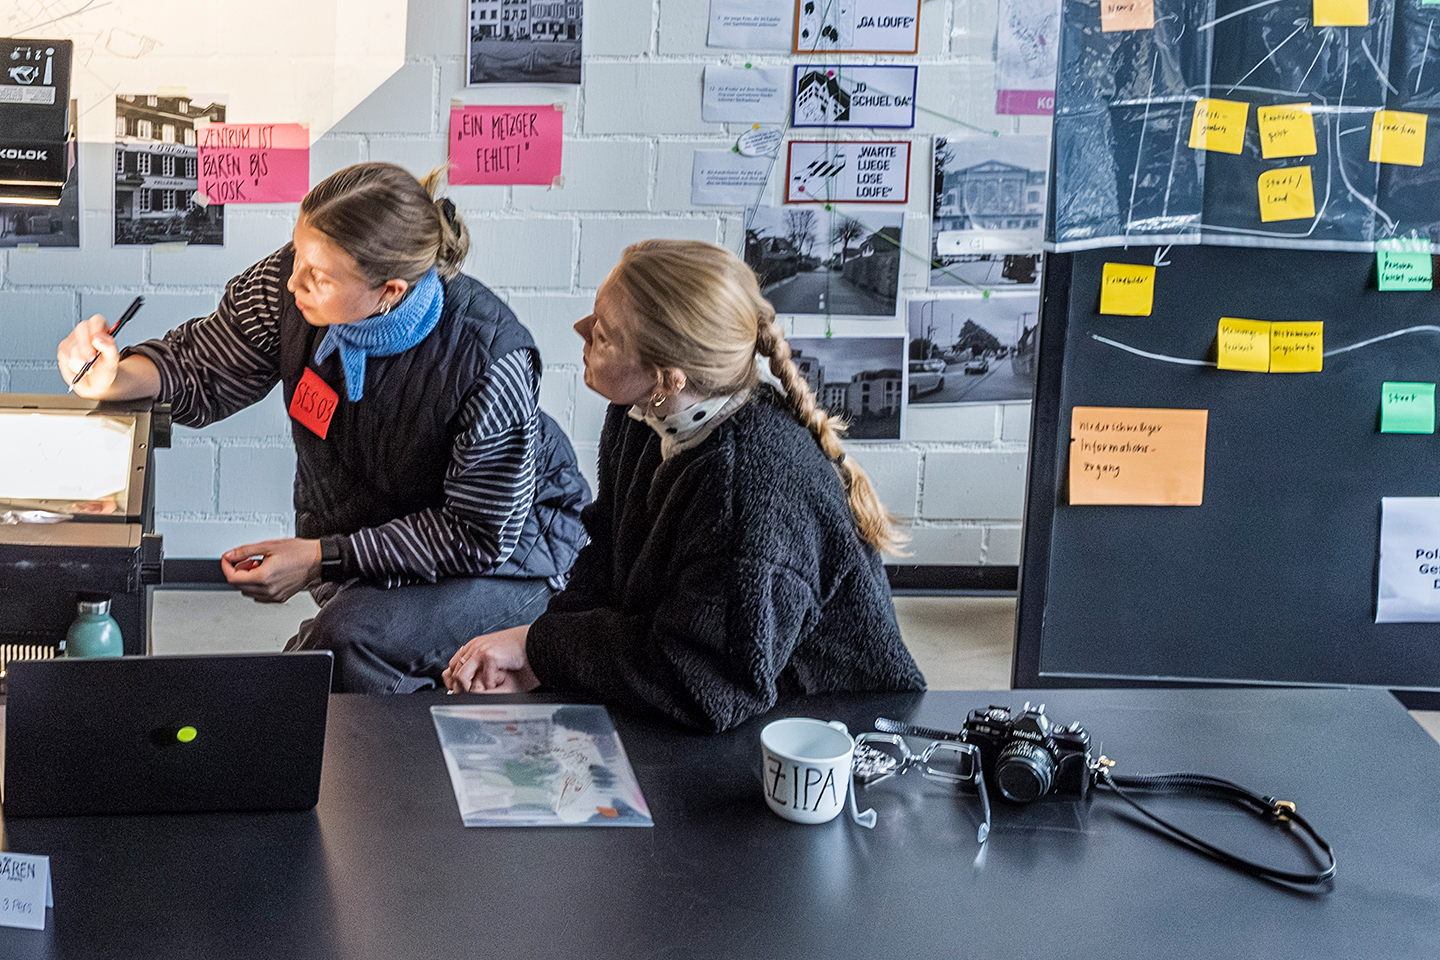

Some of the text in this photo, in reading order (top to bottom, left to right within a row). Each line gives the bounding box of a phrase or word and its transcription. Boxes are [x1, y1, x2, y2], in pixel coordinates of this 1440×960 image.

[491, 112, 539, 140] METZGER
[857, 159, 890, 172] LUEGE
[857, 173, 883, 185] LOSE
[1416, 548, 1440, 560] Pol
[1419, 563, 1440, 575] Ge
